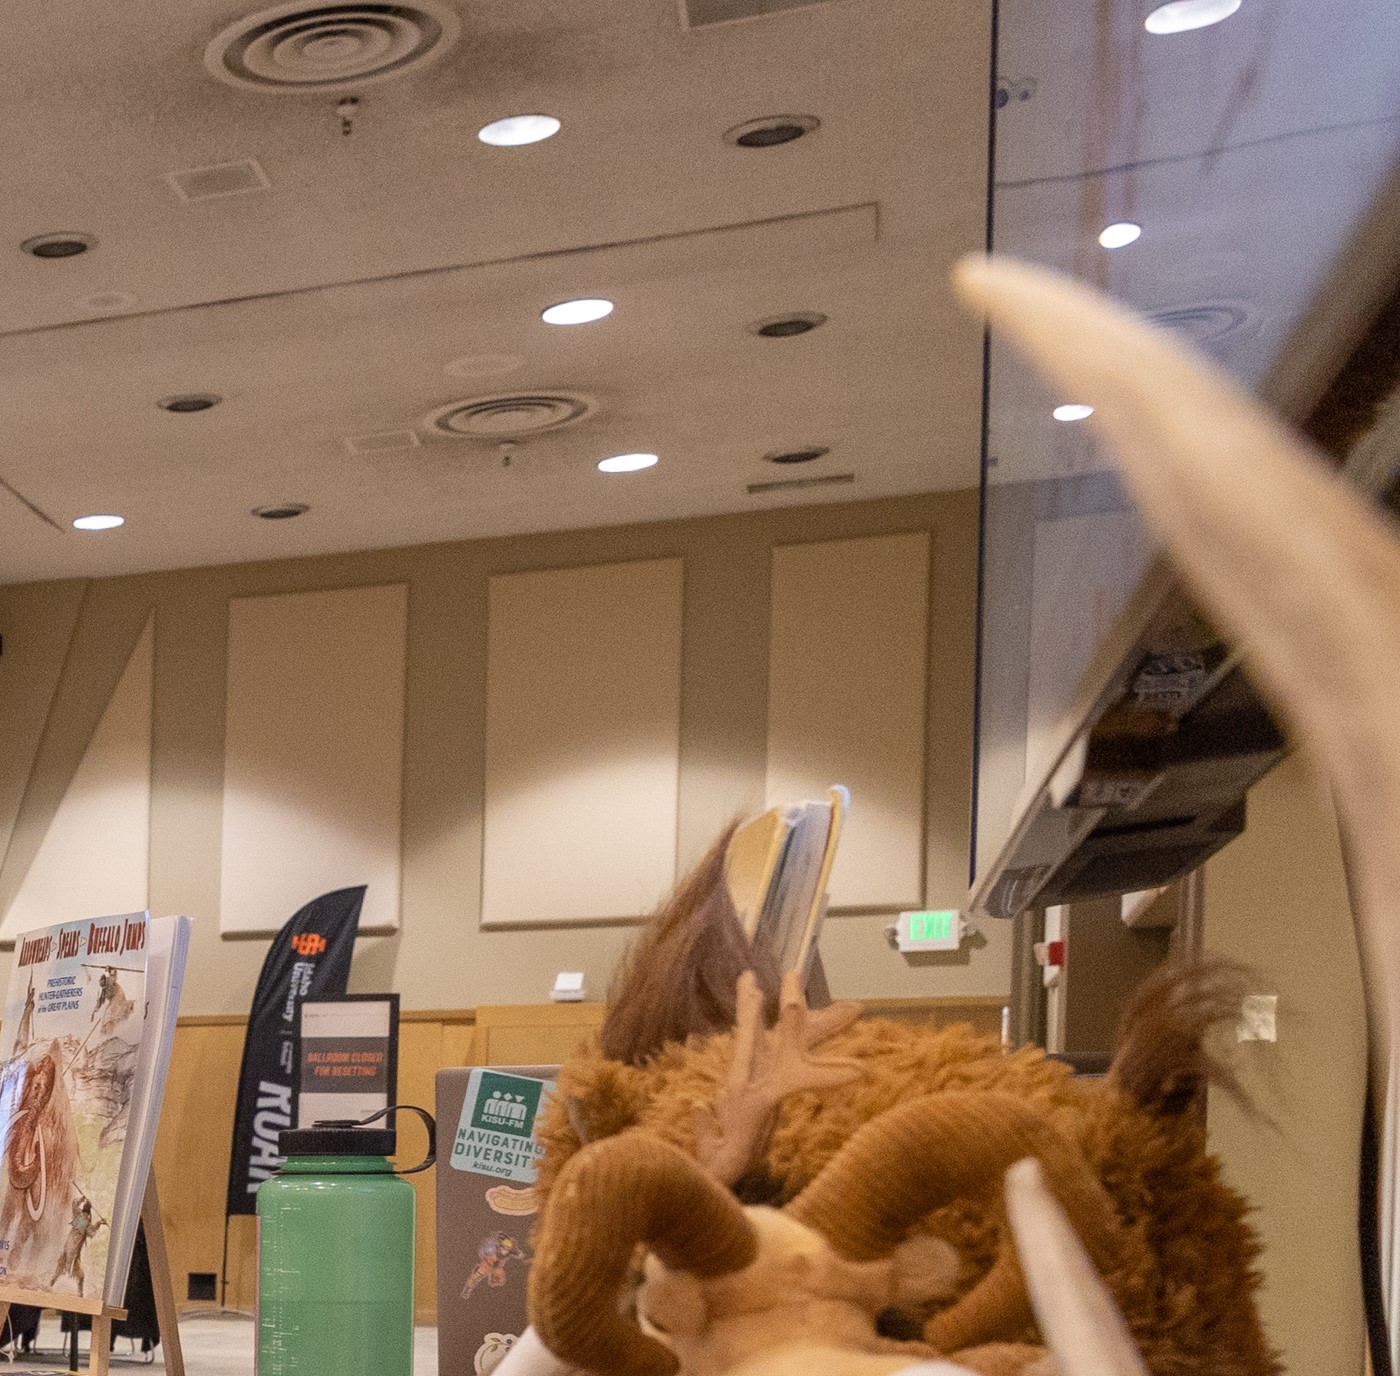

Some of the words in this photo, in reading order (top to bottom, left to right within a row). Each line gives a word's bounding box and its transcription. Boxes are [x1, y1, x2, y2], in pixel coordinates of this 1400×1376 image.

[910, 912, 952, 940] EXIT
[87, 922, 121, 956] BUFFALO
[120, 918, 146, 956] JUMPS
[299, 962, 315, 996] Idaho
[47, 1002, 62, 1013] GREAT
[62, 1000, 79, 1011] PLAINS
[306, 1052, 349, 1063] BALLROOM
[351, 1052, 383, 1063] CLOSED
[314, 1066, 330, 1076] FOR
[481, 1114, 525, 1129] KISU-FM
[458, 1128, 544, 1155] NAVIGATING
[454, 1143, 535, 1168] DIVERSIT
[473, 1161, 513, 1177] kisu.org
